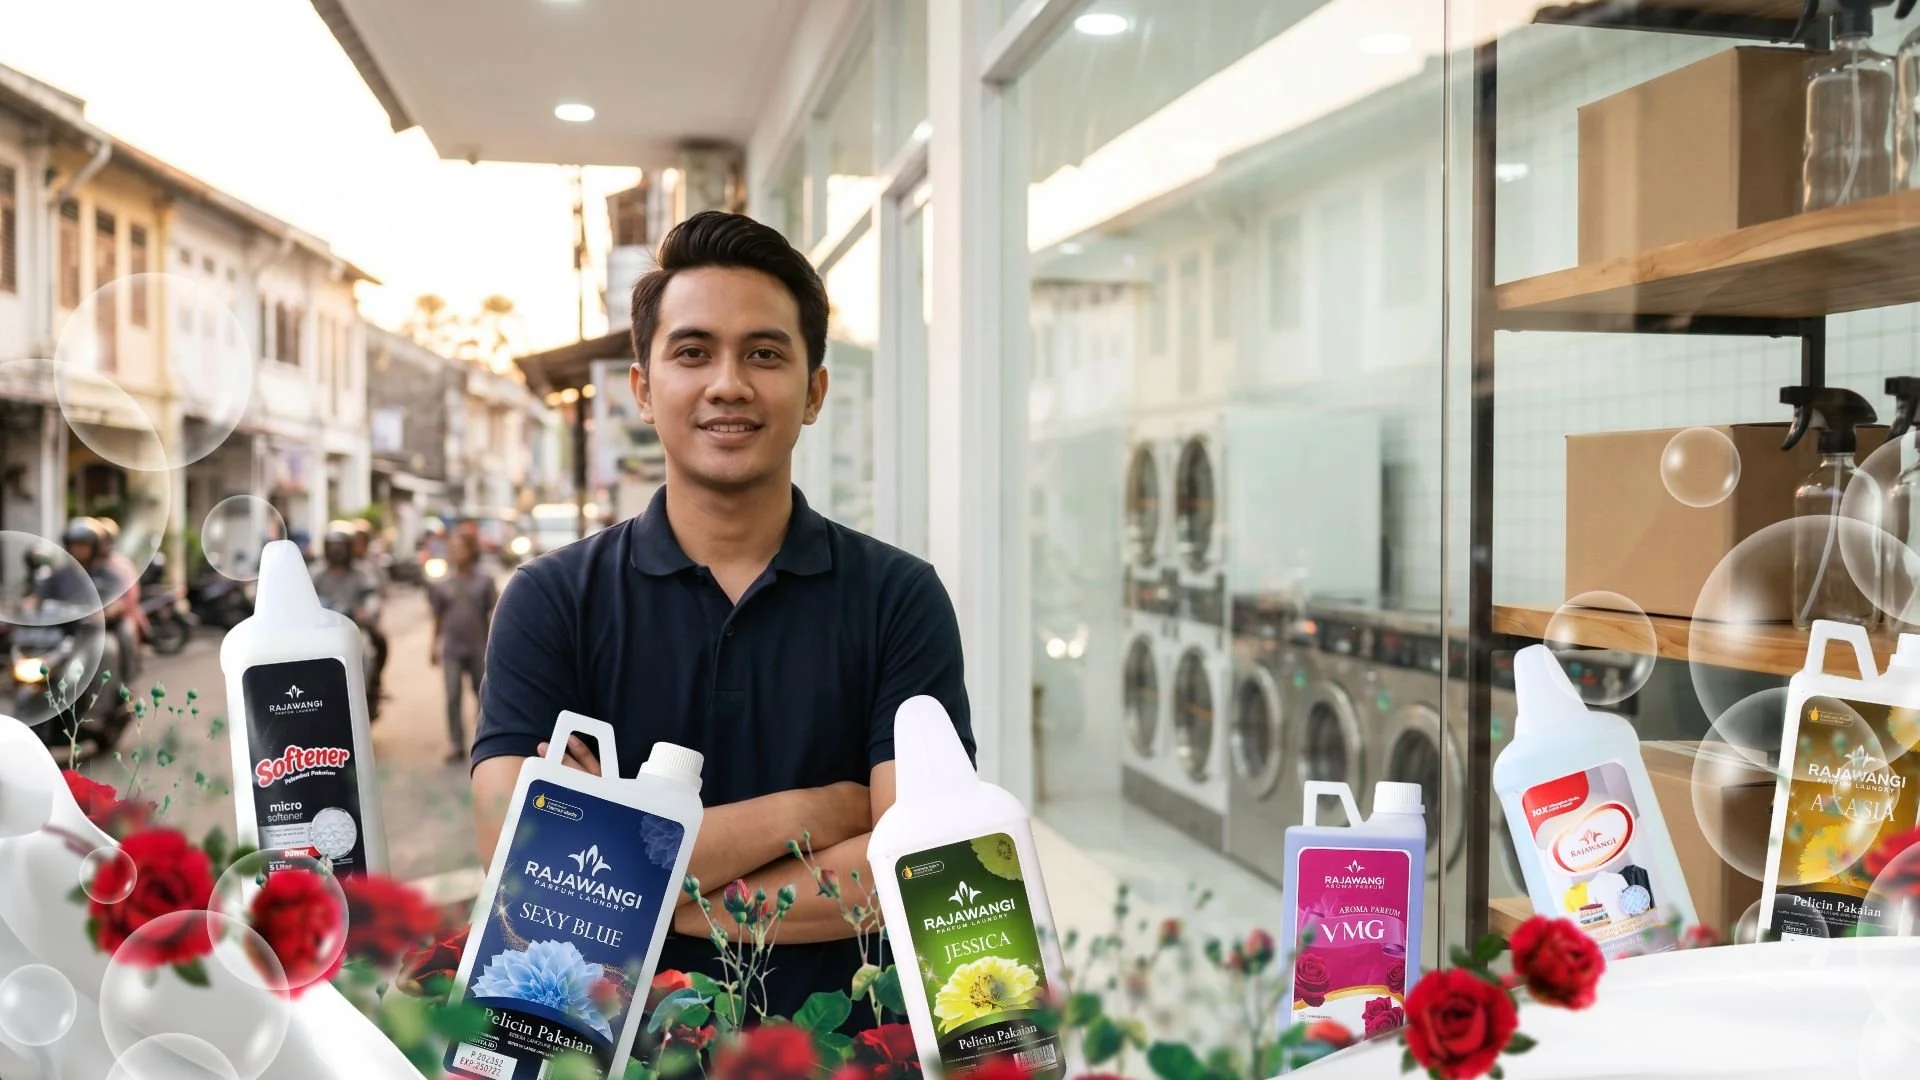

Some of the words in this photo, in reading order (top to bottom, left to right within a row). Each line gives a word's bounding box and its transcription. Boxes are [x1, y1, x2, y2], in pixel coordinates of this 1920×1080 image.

[269, 700, 323, 712] RAJAWANGI
[256, 745, 350, 788] Softener
[284, 771, 310, 785] Pelembut
[311, 769, 336, 778] Pakaian
[1808, 763, 1906, 789] RAJAWANGI
[1855, 783, 1895, 793] LAUNDRY
[267, 811, 303, 823] softener
[270, 801, 302, 812] micro
[1532, 806, 1549, 817] 10X
[1809, 793, 1896, 822] AASIA
[1570, 837, 1617, 858] RAJAWANGI
[524, 860, 643, 910] RAJAWANGI
[1324, 876, 1385, 885] RAJAWANGI
[534, 879, 575, 897] PARFUM
[579, 894, 626, 913] LAUNDRY
[1792, 895, 1833, 911] Pelicin
[1837, 901, 1881, 917] Pakaian
[923, 898, 1016, 931] RAJAWANGI
[1340, 906, 1368, 914] AROMA
[519, 902, 571, 930] SEXY
[572, 918, 623, 948] BLUE
[936, 923, 968, 934] PARFUM
[971, 913, 1008, 926] LAUNDRY
[1321, 919, 1386, 943] VMG
[944, 931, 1011, 964] JESSICA
[483, 1007, 532, 1036] Pelicin
[538, 1025, 593, 1055] Pakaian
[958, 1034, 995, 1050] Pelicin
[997, 1024, 1038, 1041] Pakaian
